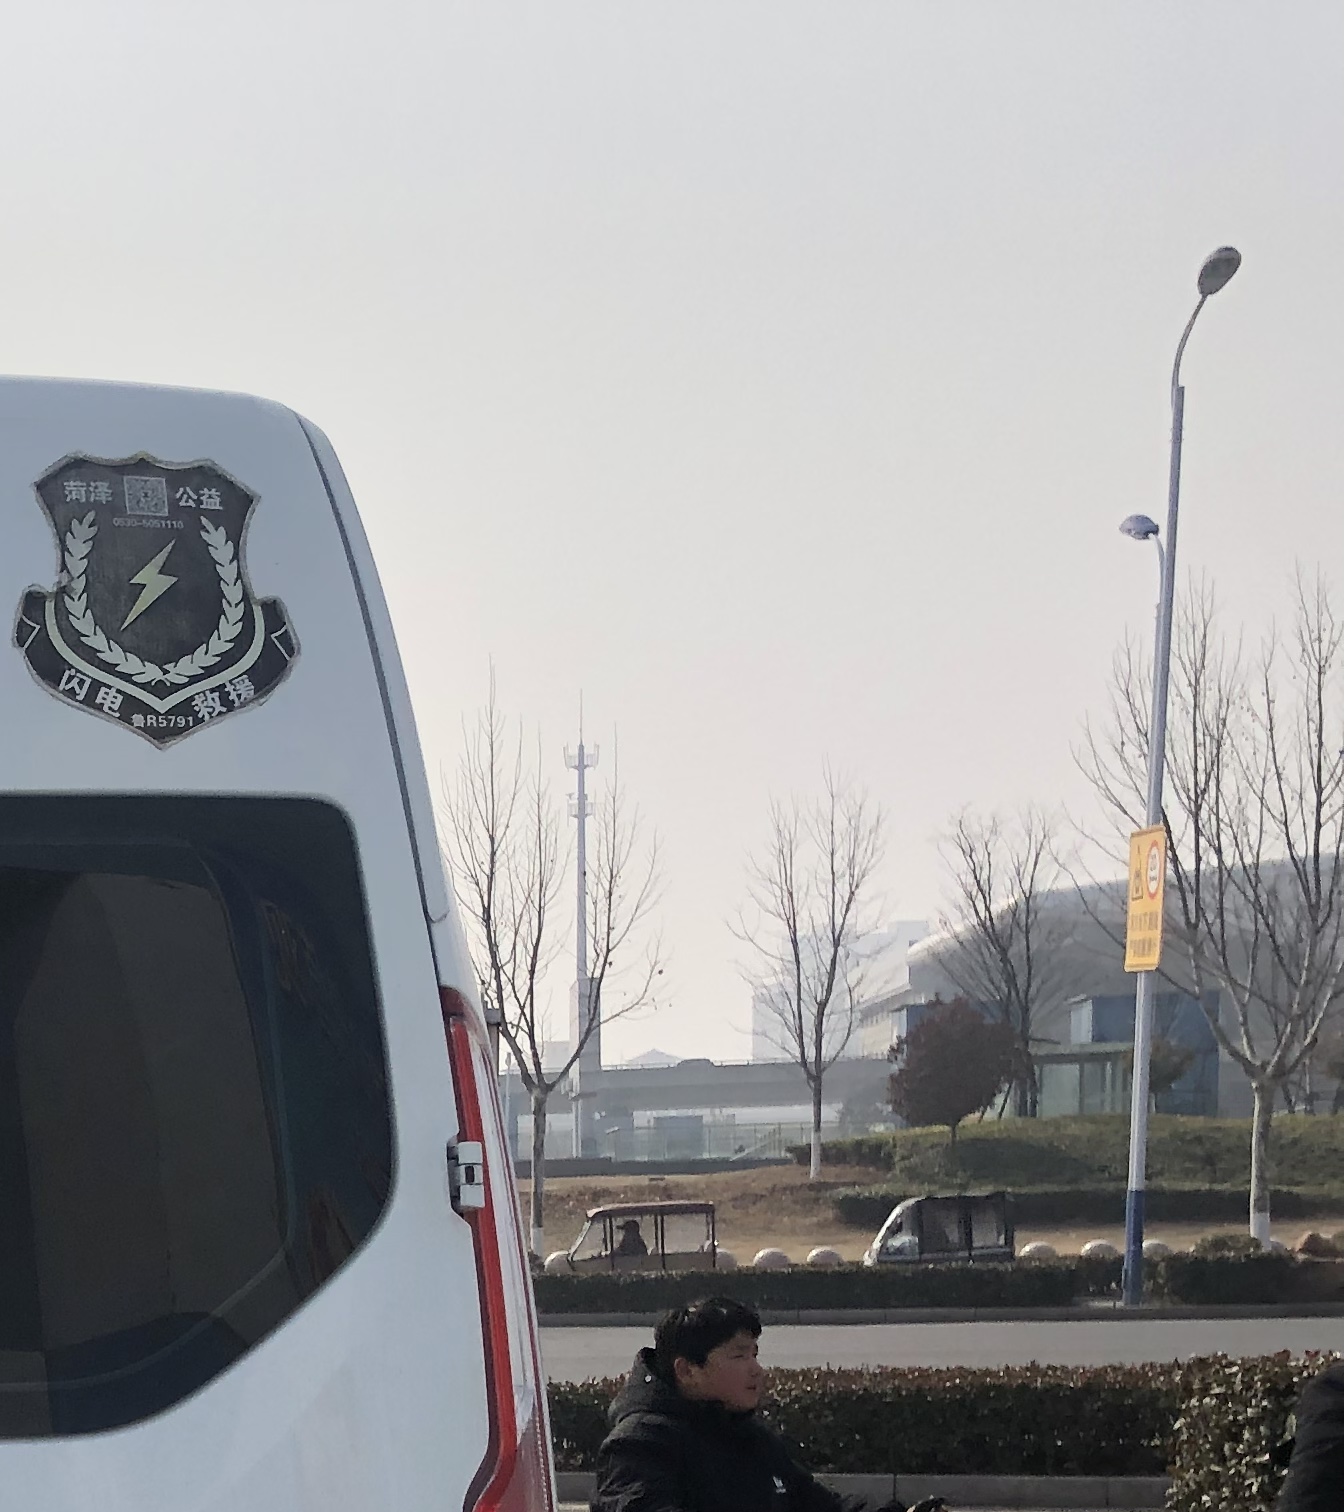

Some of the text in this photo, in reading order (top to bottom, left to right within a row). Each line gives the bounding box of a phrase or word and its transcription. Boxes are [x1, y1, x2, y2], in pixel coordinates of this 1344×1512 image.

[63, 480, 224, 510] 菏泽 公益
[58, 668, 256, 721] 闪电 救援
